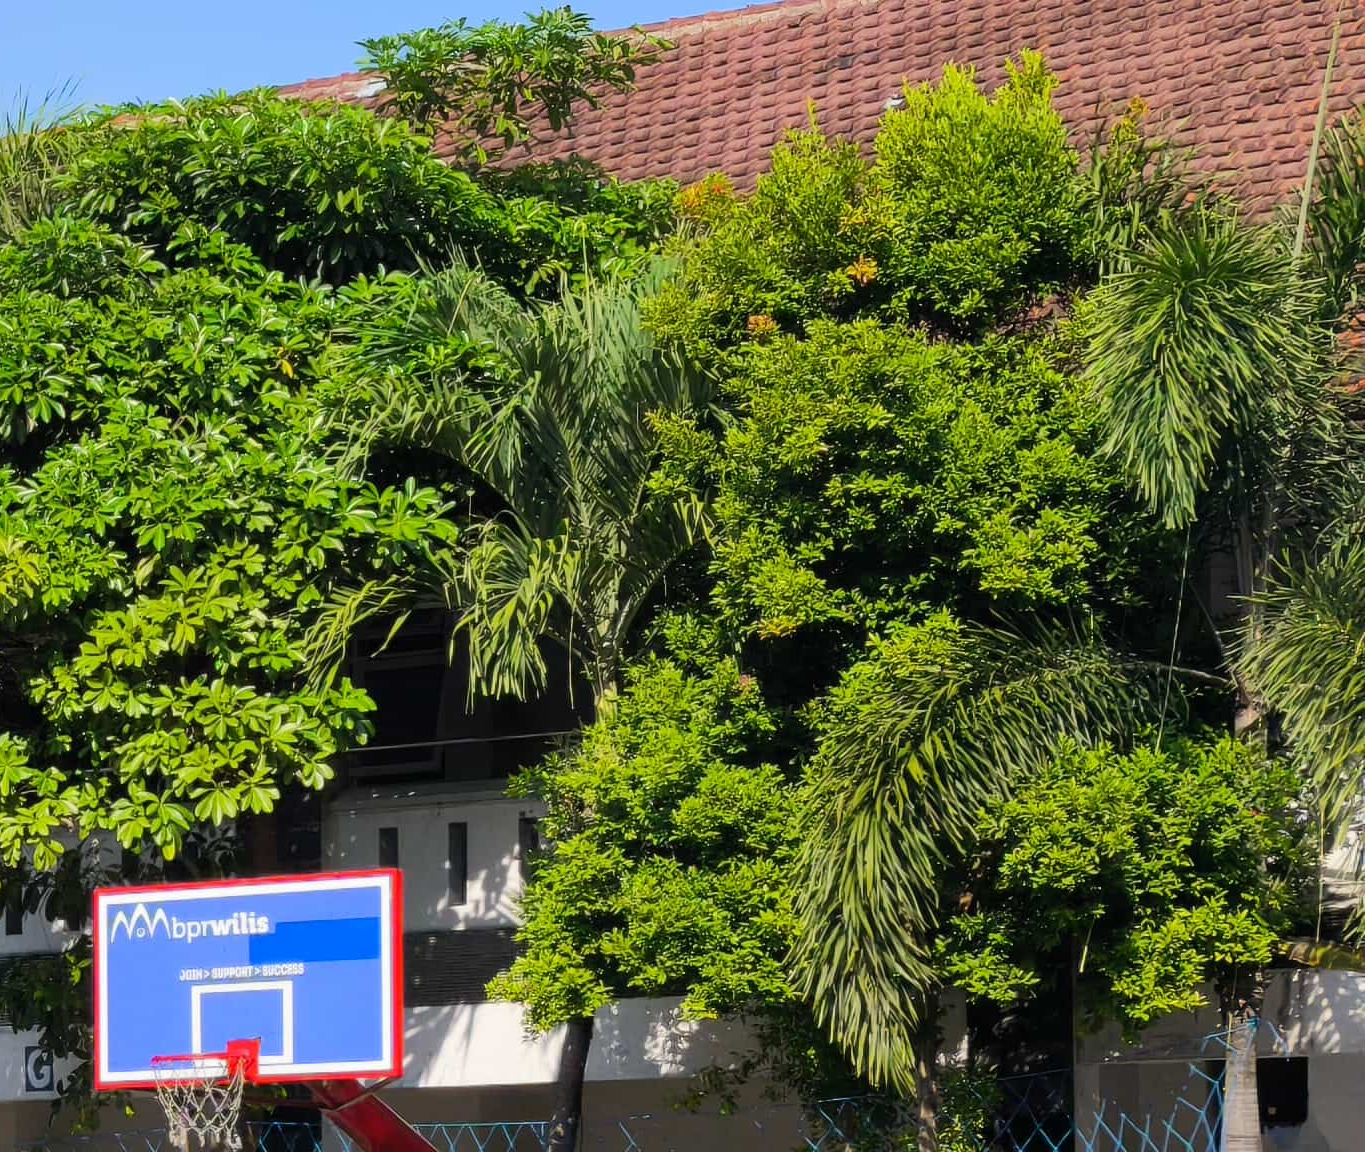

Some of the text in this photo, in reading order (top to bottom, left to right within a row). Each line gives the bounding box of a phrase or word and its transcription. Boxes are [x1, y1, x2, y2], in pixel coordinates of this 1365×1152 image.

[172, 912, 270, 944] bprwilis
[179, 963, 304, 981] JOIN SUPPORT SUCCESS
